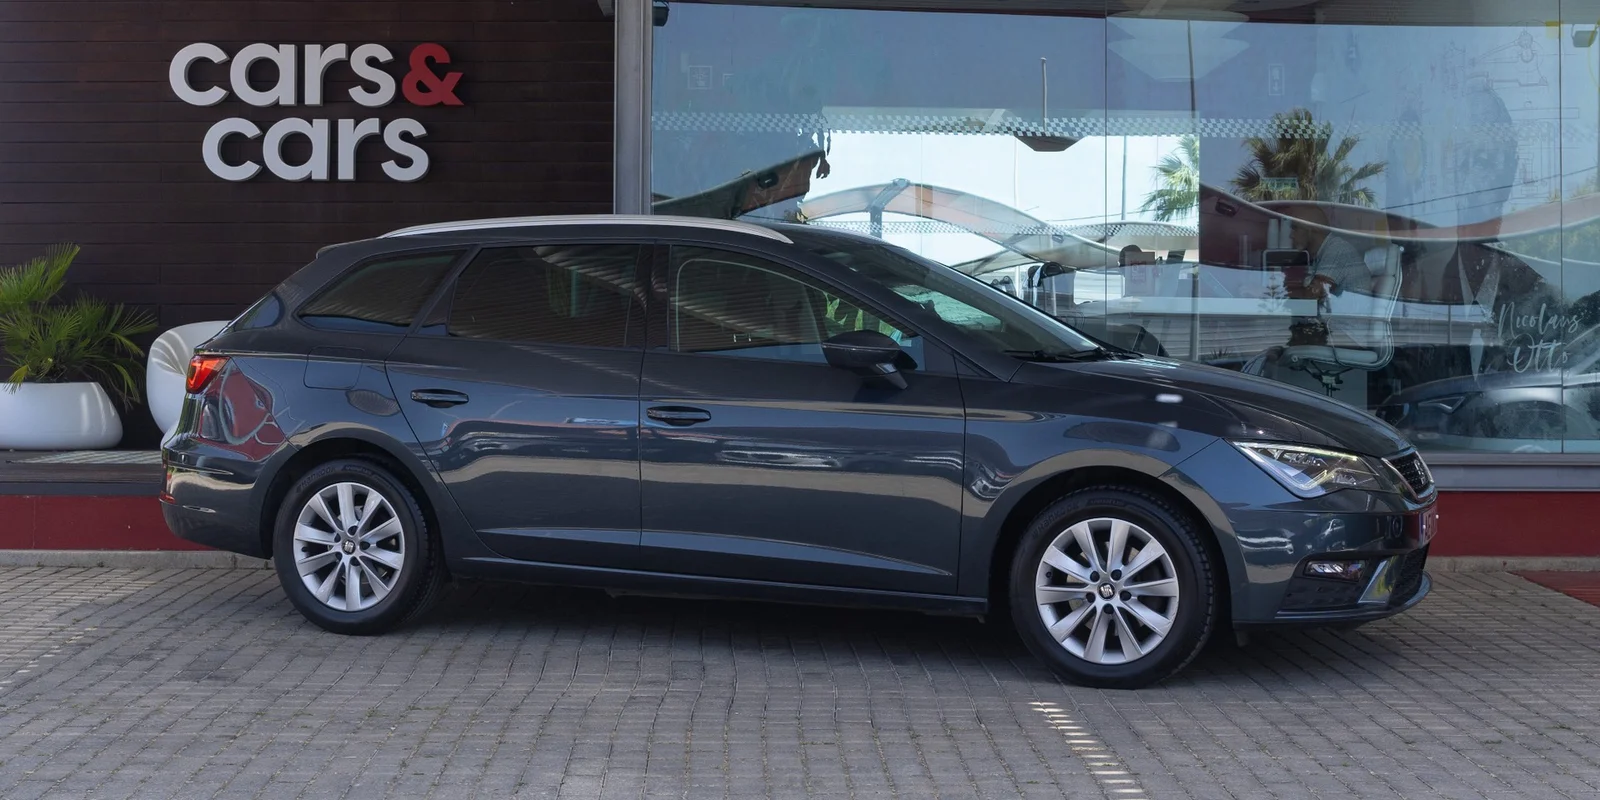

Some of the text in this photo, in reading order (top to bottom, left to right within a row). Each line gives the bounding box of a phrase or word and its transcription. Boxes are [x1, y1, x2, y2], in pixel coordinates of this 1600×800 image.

[169, 42, 464, 107] cars&
[202, 117, 430, 182] cars
[1506, 333, 1571, 373] Otto
